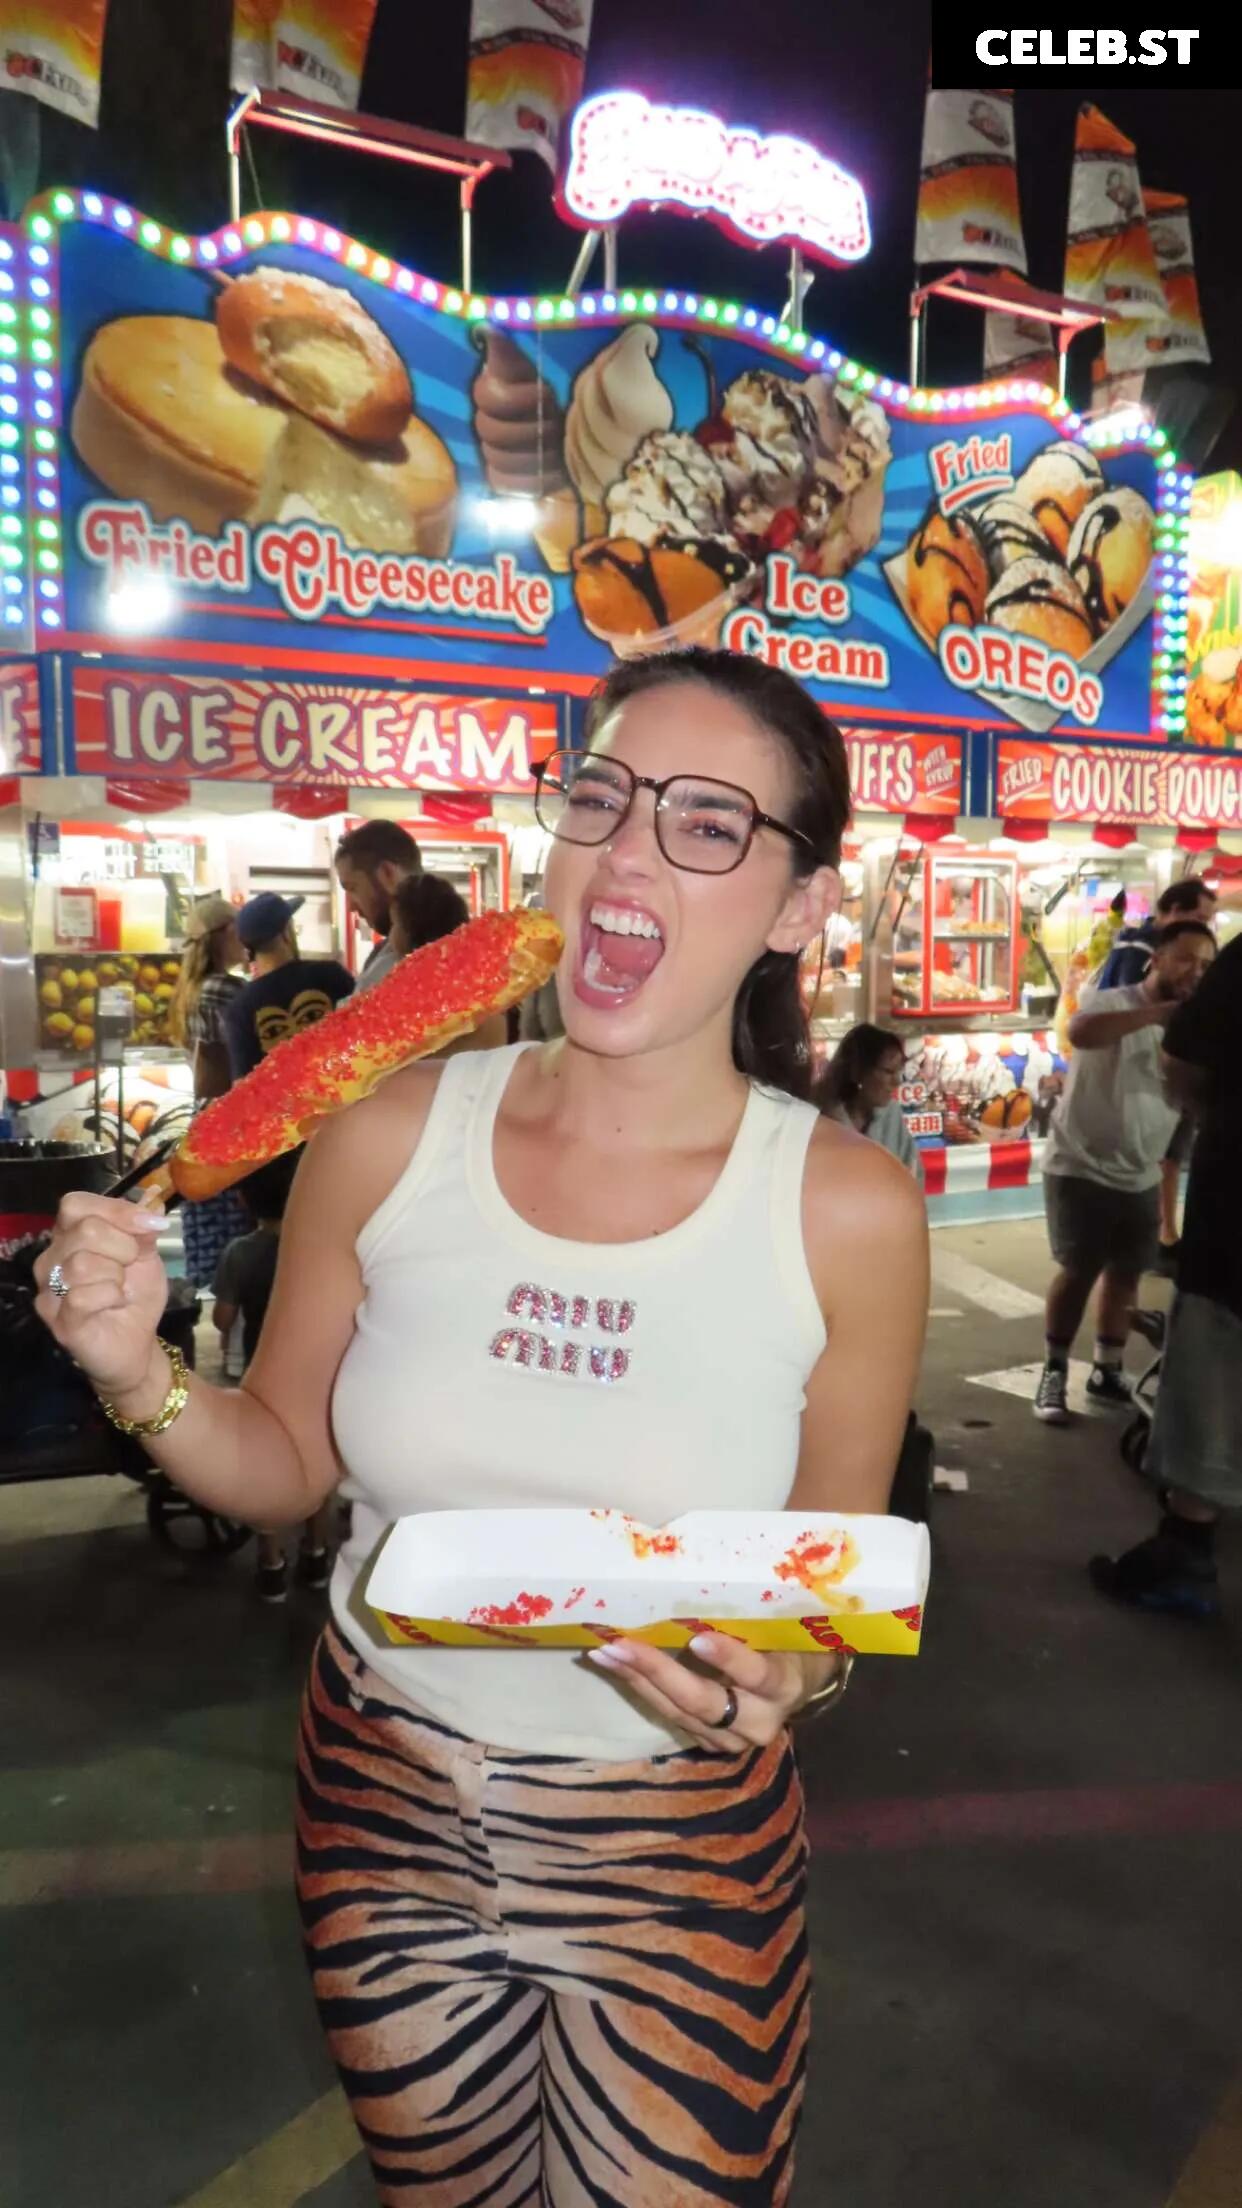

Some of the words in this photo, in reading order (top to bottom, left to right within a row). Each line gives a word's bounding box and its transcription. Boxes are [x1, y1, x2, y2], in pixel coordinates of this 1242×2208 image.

[931, 433, 1011, 488] Fried
[84, 508, 245, 594] Fried
[260, 526, 552, 629] Cheesecake
[766, 559, 849, 619] Ice
[724, 613, 888, 681] Cream
[943, 630, 1104, 722] OREOS
[109, 684, 232, 766] ICE
[258, 696, 534, 783] CREAM
[1002, 757, 1042, 795] FRIED
[1053, 756, 1160, 814] COOKIE
[1168, 765, 1242, 819] DOUG
[505, 1281, 638, 1336] miu
[488, 1326, 633, 1384] miu
